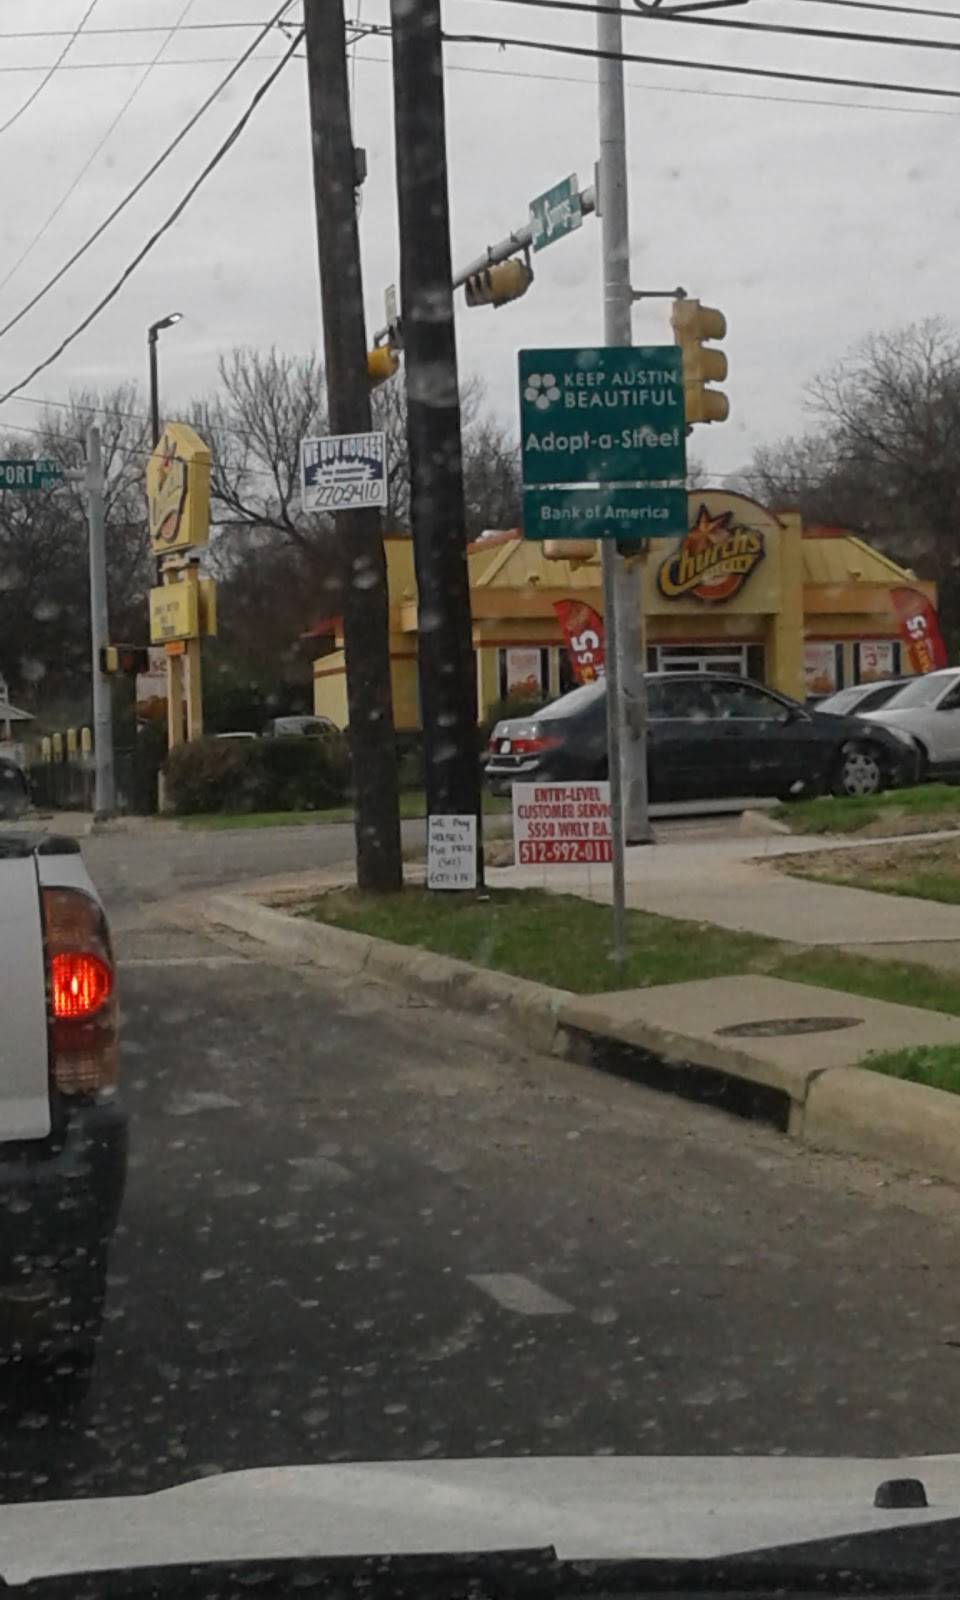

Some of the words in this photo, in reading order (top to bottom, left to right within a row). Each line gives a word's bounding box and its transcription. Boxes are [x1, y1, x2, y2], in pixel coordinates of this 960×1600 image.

[564, 371, 606, 387] KEEP
[611, 370, 678, 386] AUSTIN
[564, 389, 677, 409] BEAUTIFUL
[525, 428, 680, 454] Adopt-a-Street
[540, 505, 580, 520] Bank
[584, 505, 601, 519] of
[604, 503, 670, 519] America
[534, 787, 601, 803] ENTRY-LEVEL
[518, 804, 575, 819] CUSTOMER
[521, 841, 614, 863] 512-992-011
